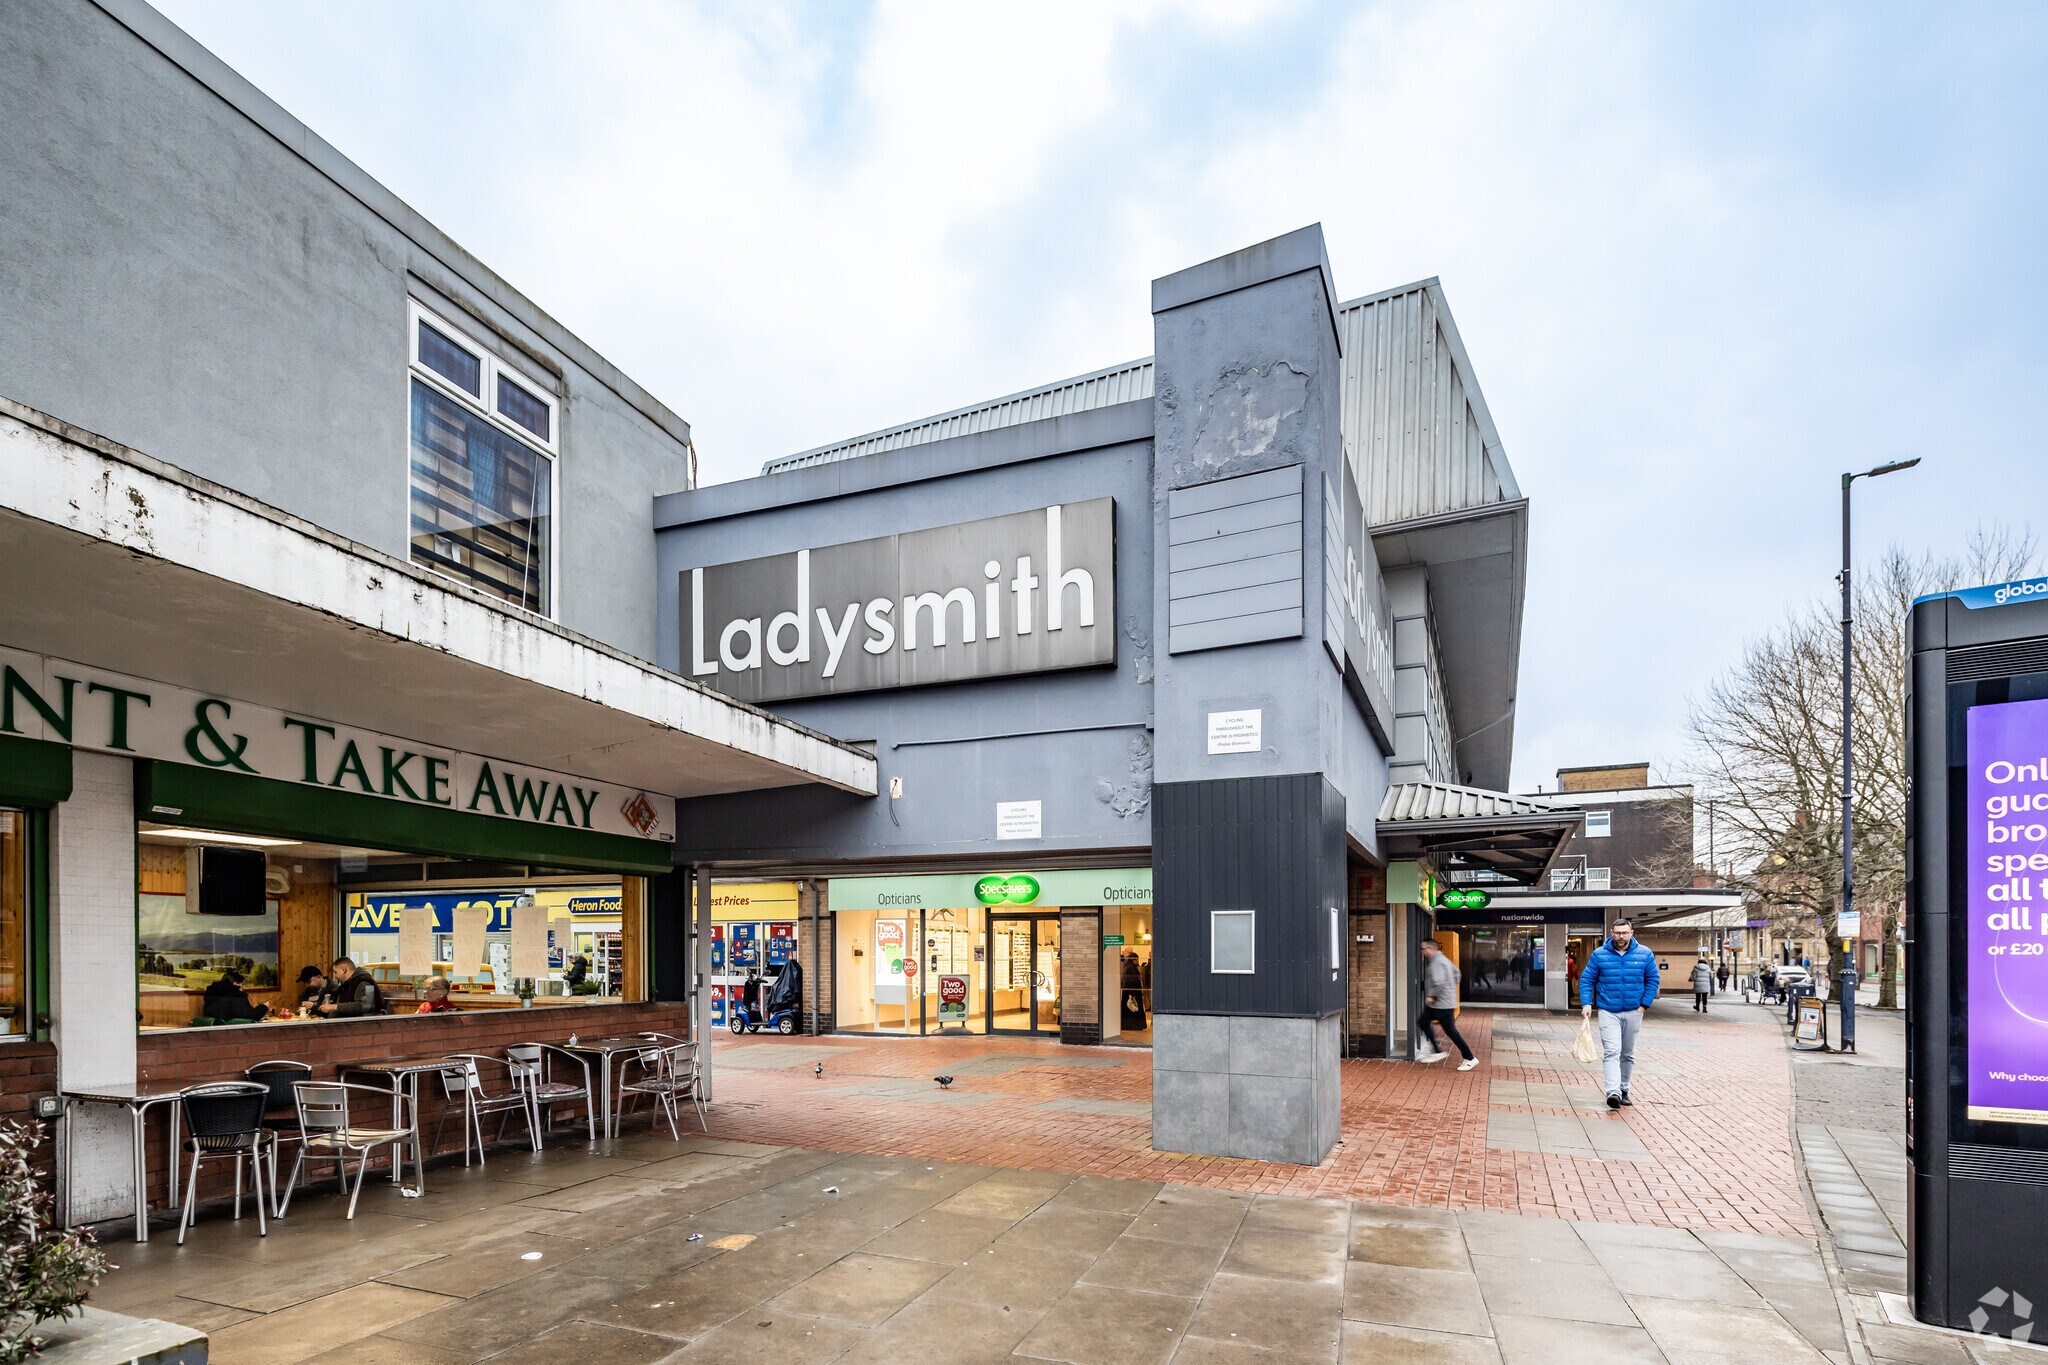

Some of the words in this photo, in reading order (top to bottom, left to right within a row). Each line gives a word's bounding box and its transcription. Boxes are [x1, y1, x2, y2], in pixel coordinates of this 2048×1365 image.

[691, 505, 1095, 678] Ladysmith
[0, 665, 151, 752] NT
[185, 699, 261, 774] &
[284, 716, 451, 806] TAKE
[467, 761, 601, 829] AWAY
[1988, 821, 2048, 843] bro
[1987, 853, 2048, 877] spe
[979, 882, 1033, 896] Specsavers
[1987, 878, 2032, 901] all
[571, 900, 597, 912] Heron
[599, 897, 622, 911] Food
[723, 895, 750, 906] Prices
[877, 892, 922, 906] Opticians
[1443, 893, 1486, 904] Specsavers
[1987, 907, 2032, 931] all
[878, 923, 896, 932] Two
[879, 930, 900, 941] good
[1987, 945, 2007, 955] or
[2010, 943, 2044, 955] £20
[942, 986, 964, 995] good
[1989, 1071, 2016, 1082] Why
